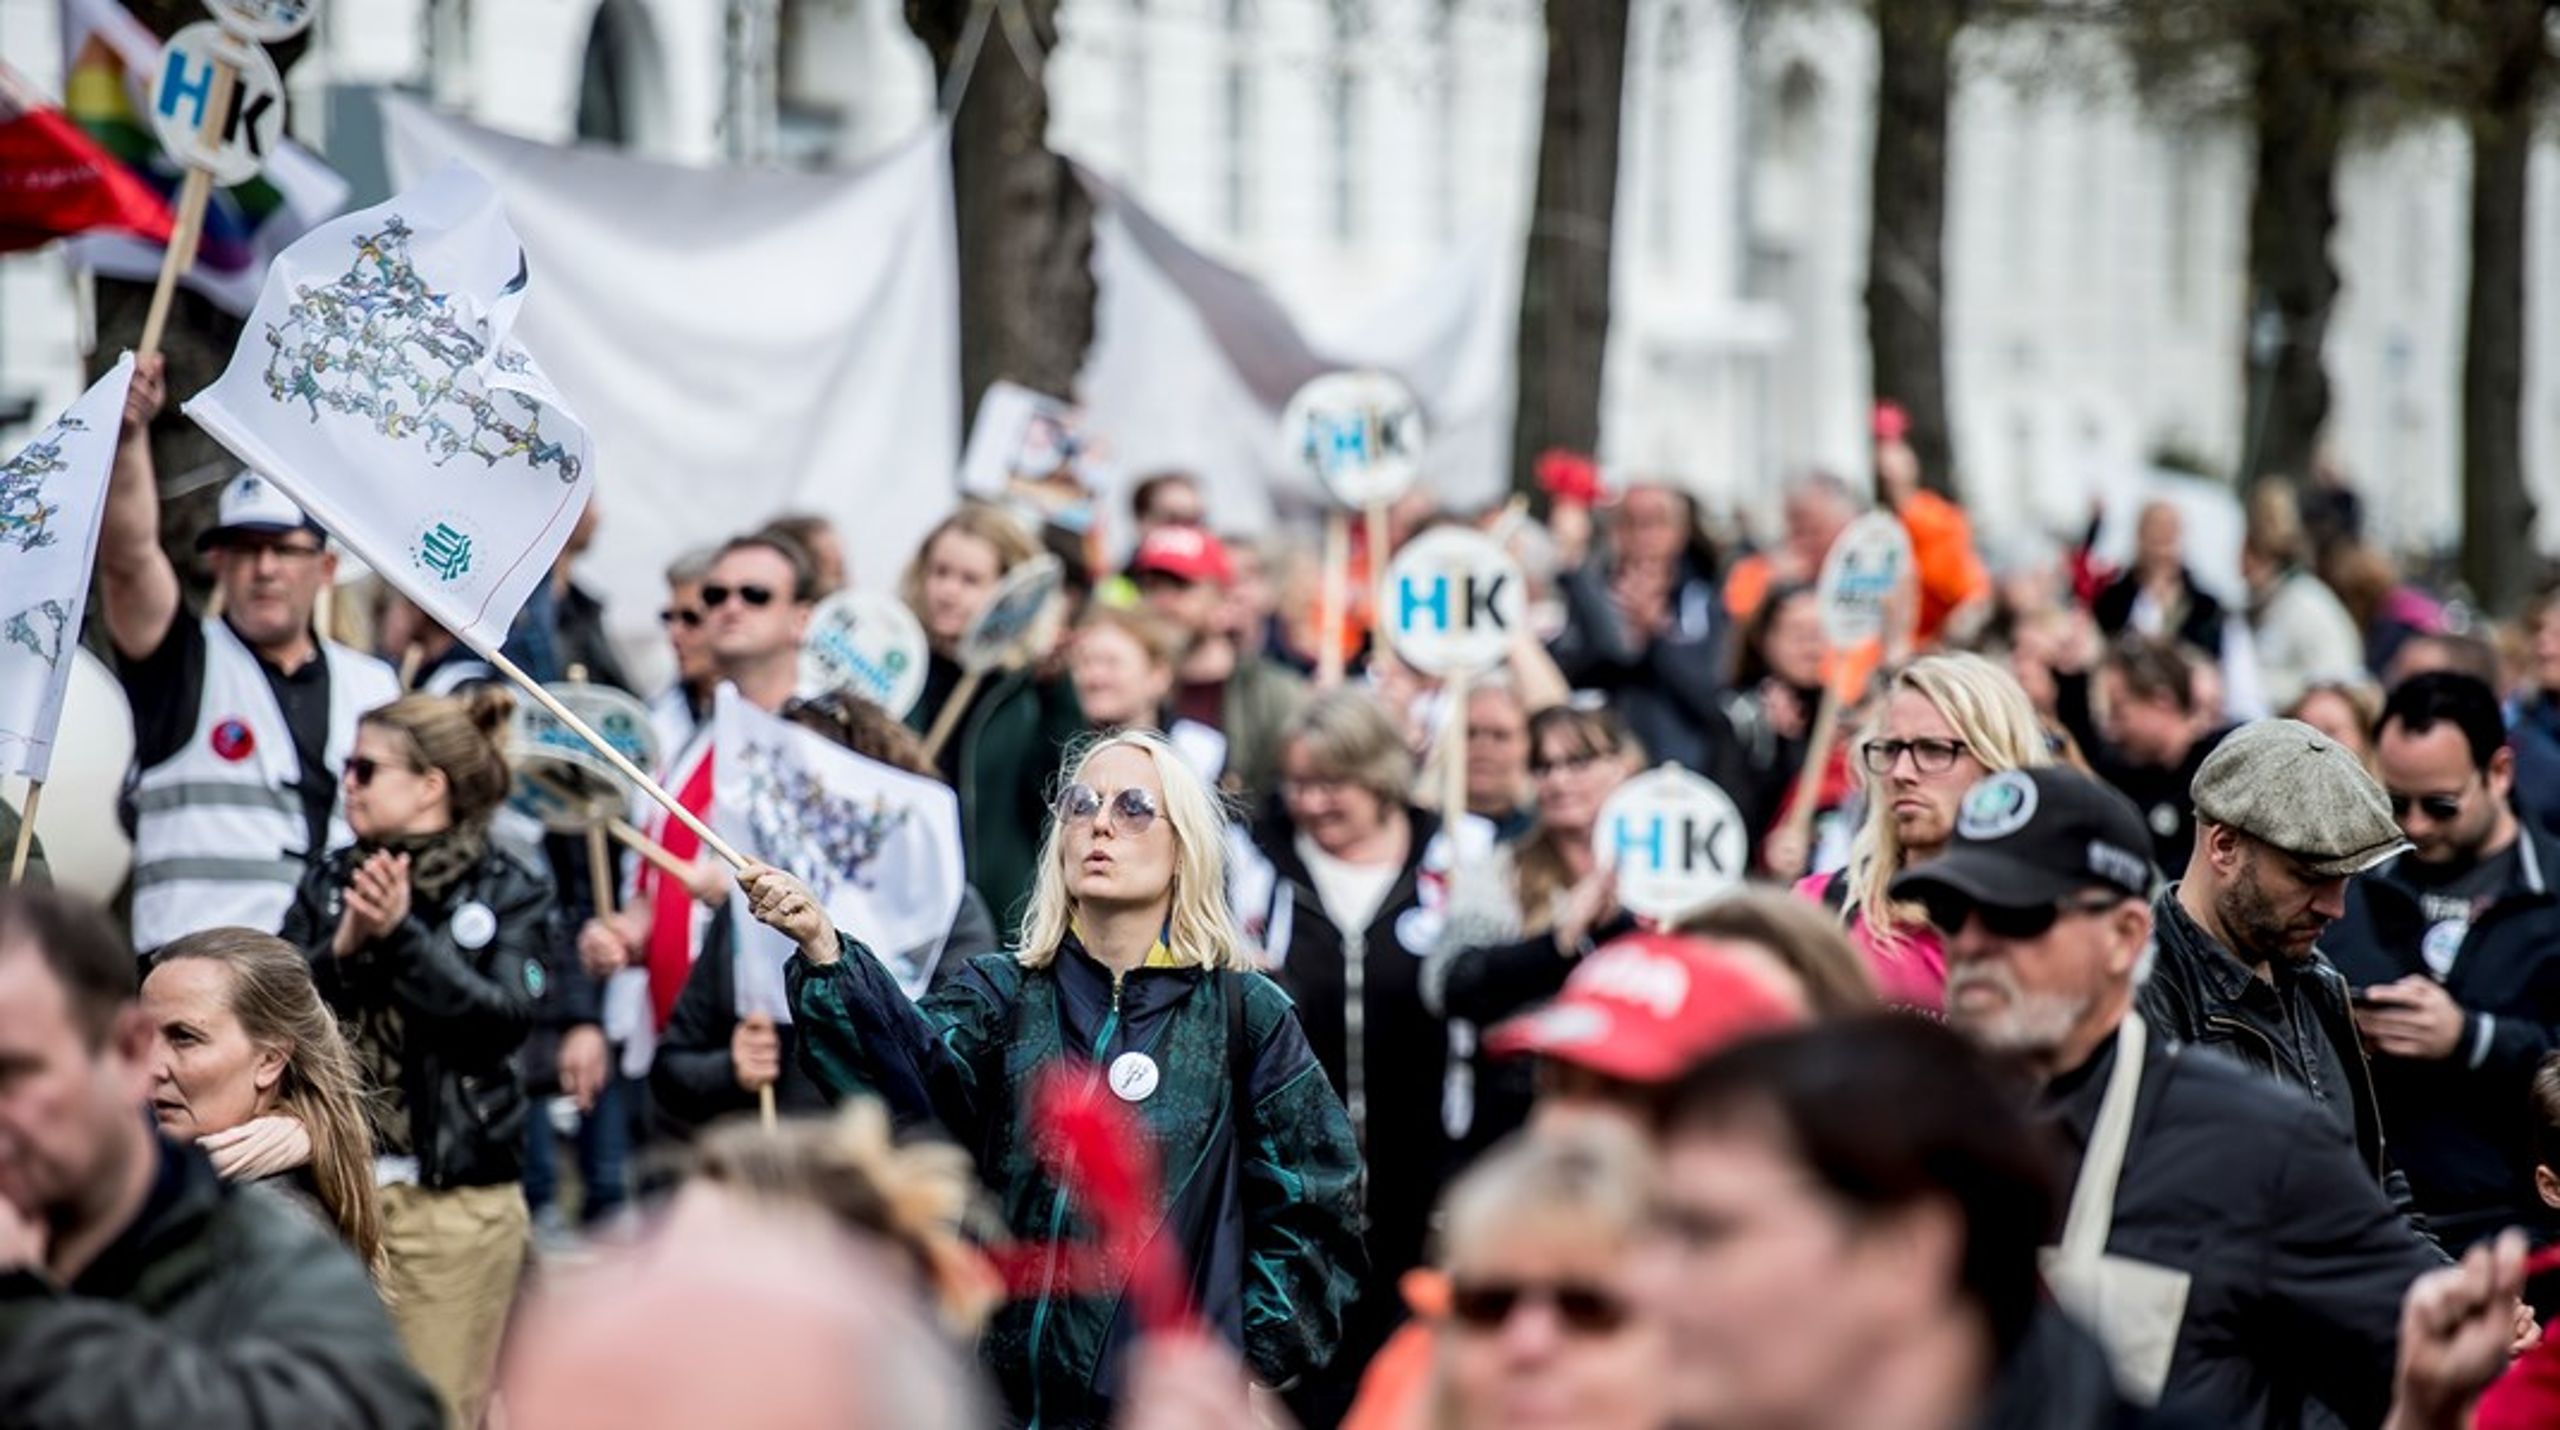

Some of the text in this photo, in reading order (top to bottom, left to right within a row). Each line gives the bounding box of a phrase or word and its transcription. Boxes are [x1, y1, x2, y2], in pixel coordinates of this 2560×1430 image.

[159, 50, 275, 156] HK
[1400, 575, 1506, 630] HK
[1615, 815, 1724, 872] HK
